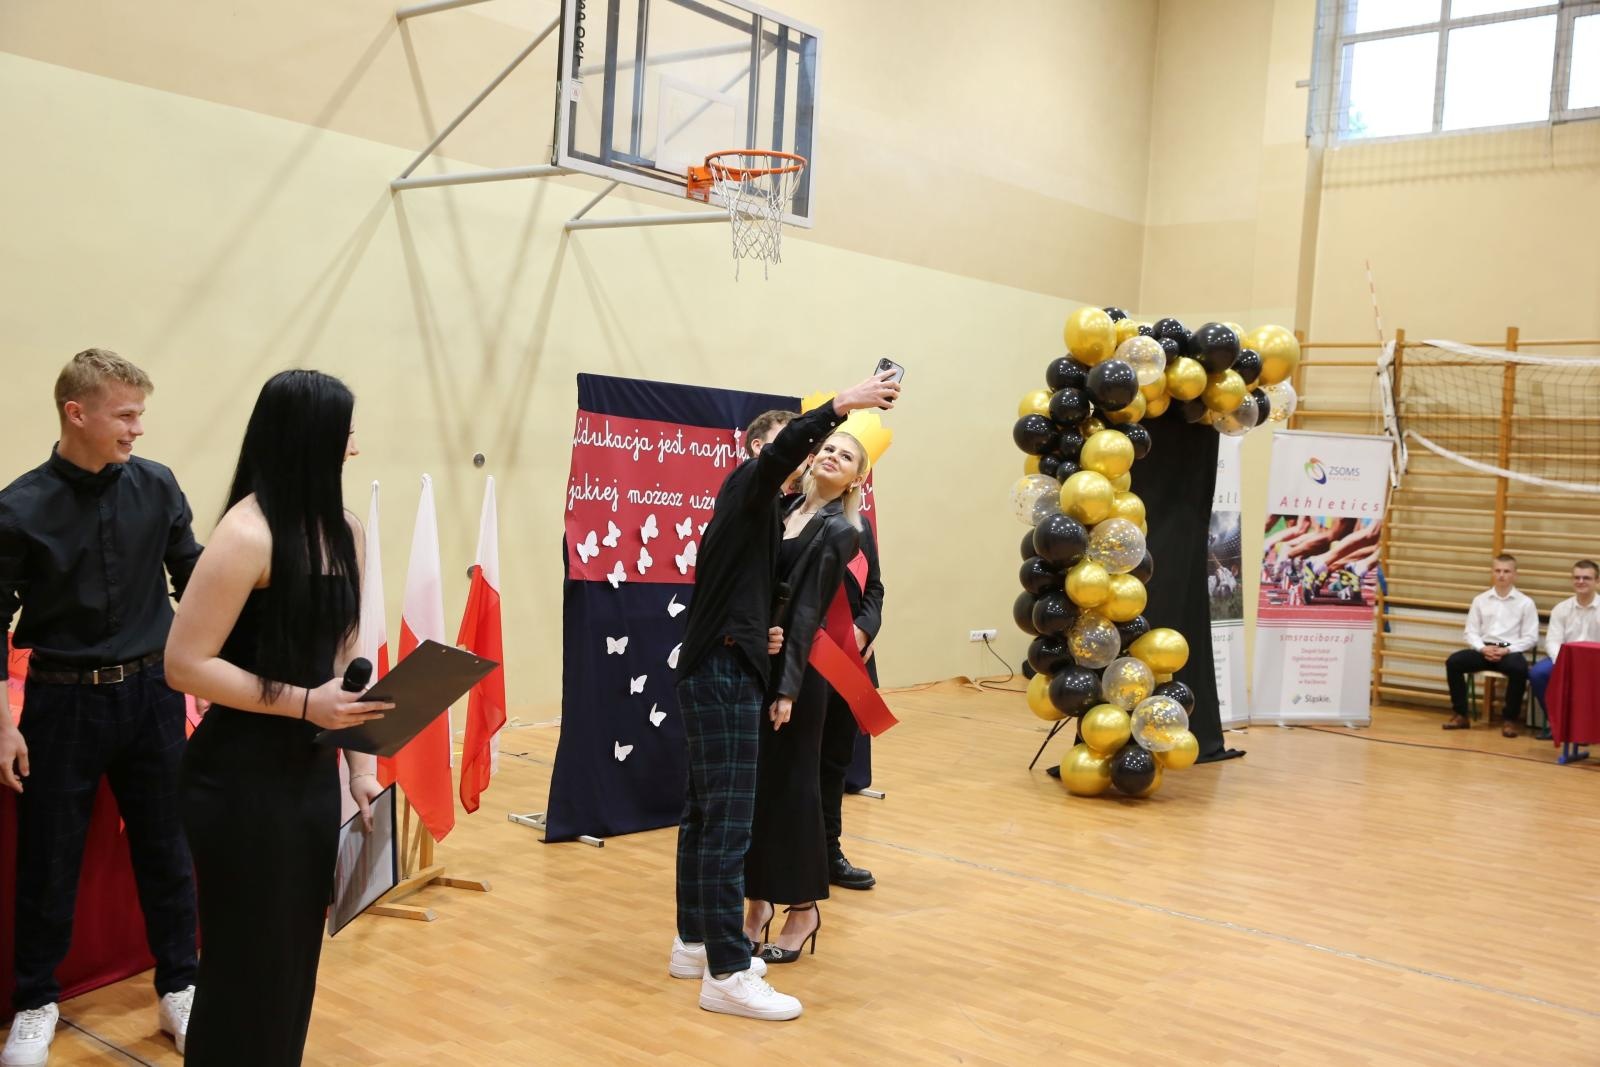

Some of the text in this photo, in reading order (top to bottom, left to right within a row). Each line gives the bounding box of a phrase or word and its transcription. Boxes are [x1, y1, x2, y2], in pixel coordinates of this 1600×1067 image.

[658, 428, 686, 463] jest
[1328, 466, 1360, 477] ZSOMS
[568, 472, 619, 512] jakiej
[627, 483, 682, 507] możesz
[1279, 495, 1381, 512] Athletics
[1279, 632, 1354, 645] smsraciborz.pl
